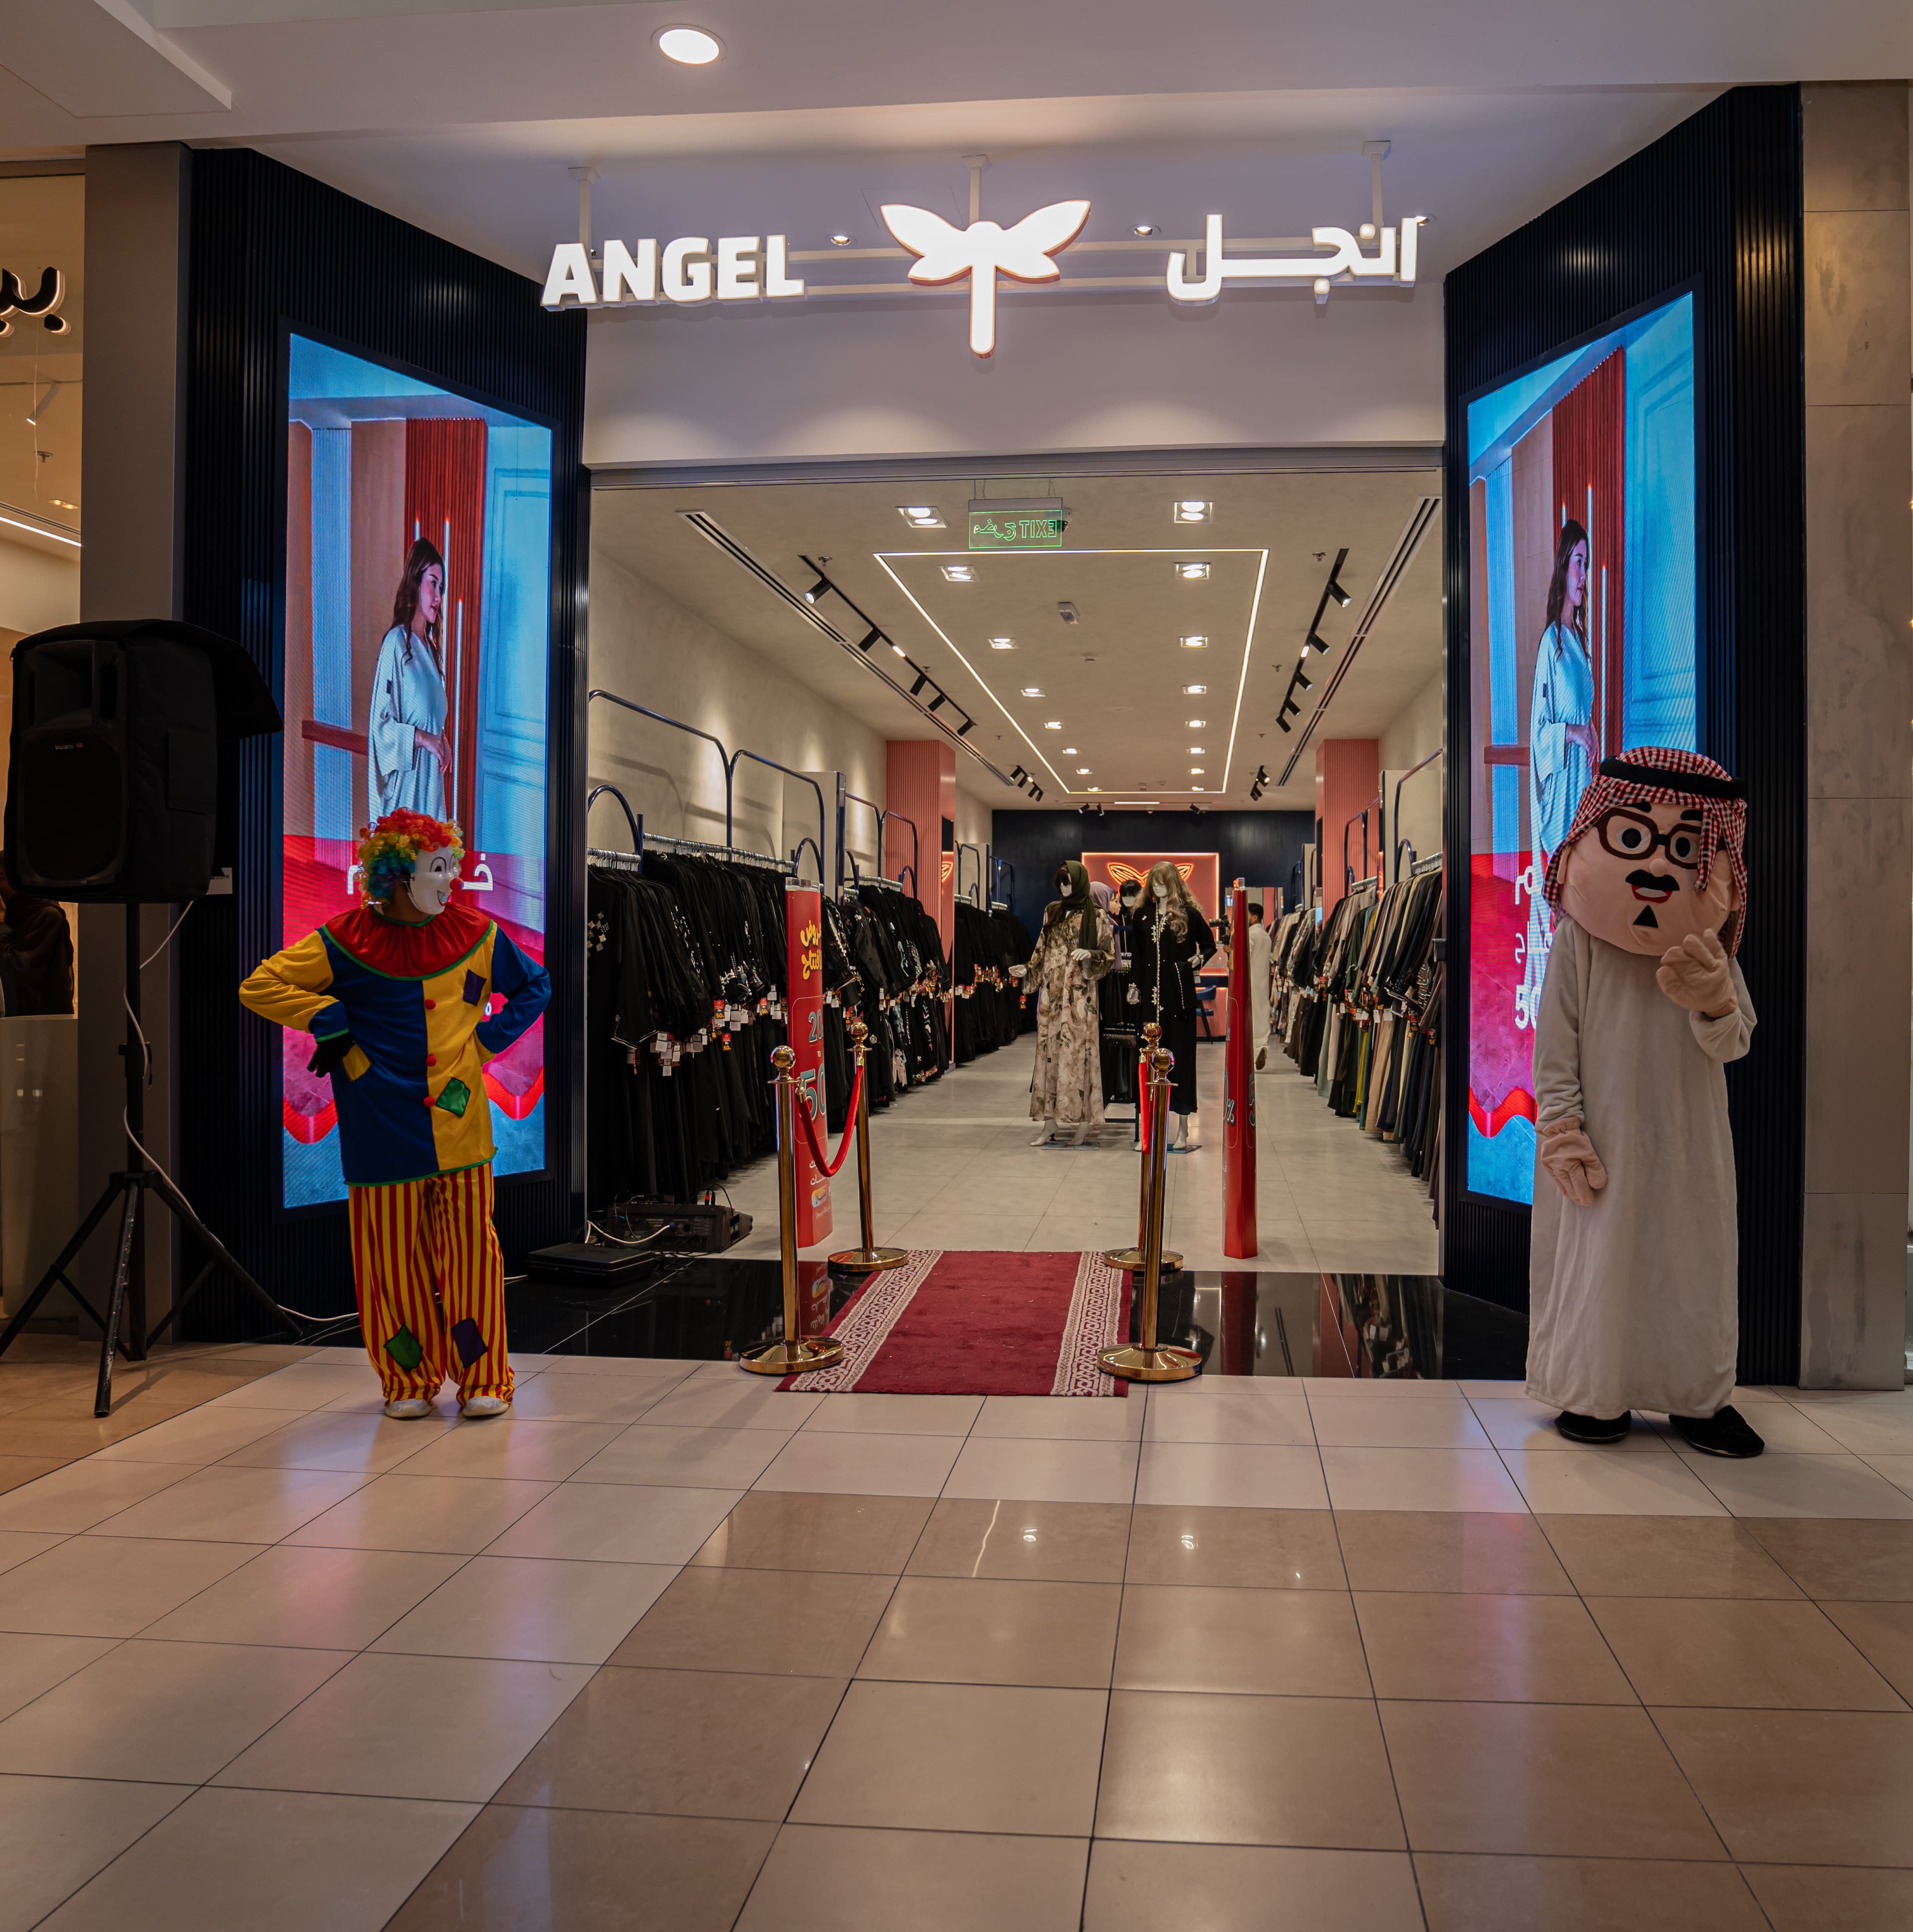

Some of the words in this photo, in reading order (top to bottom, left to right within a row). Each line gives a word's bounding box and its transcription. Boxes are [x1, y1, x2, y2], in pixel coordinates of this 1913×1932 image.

[541, 234, 805, 306] ANGEL
[1166, 214, 1418, 301] انجل
[808, 1008, 823, 1044] 20
